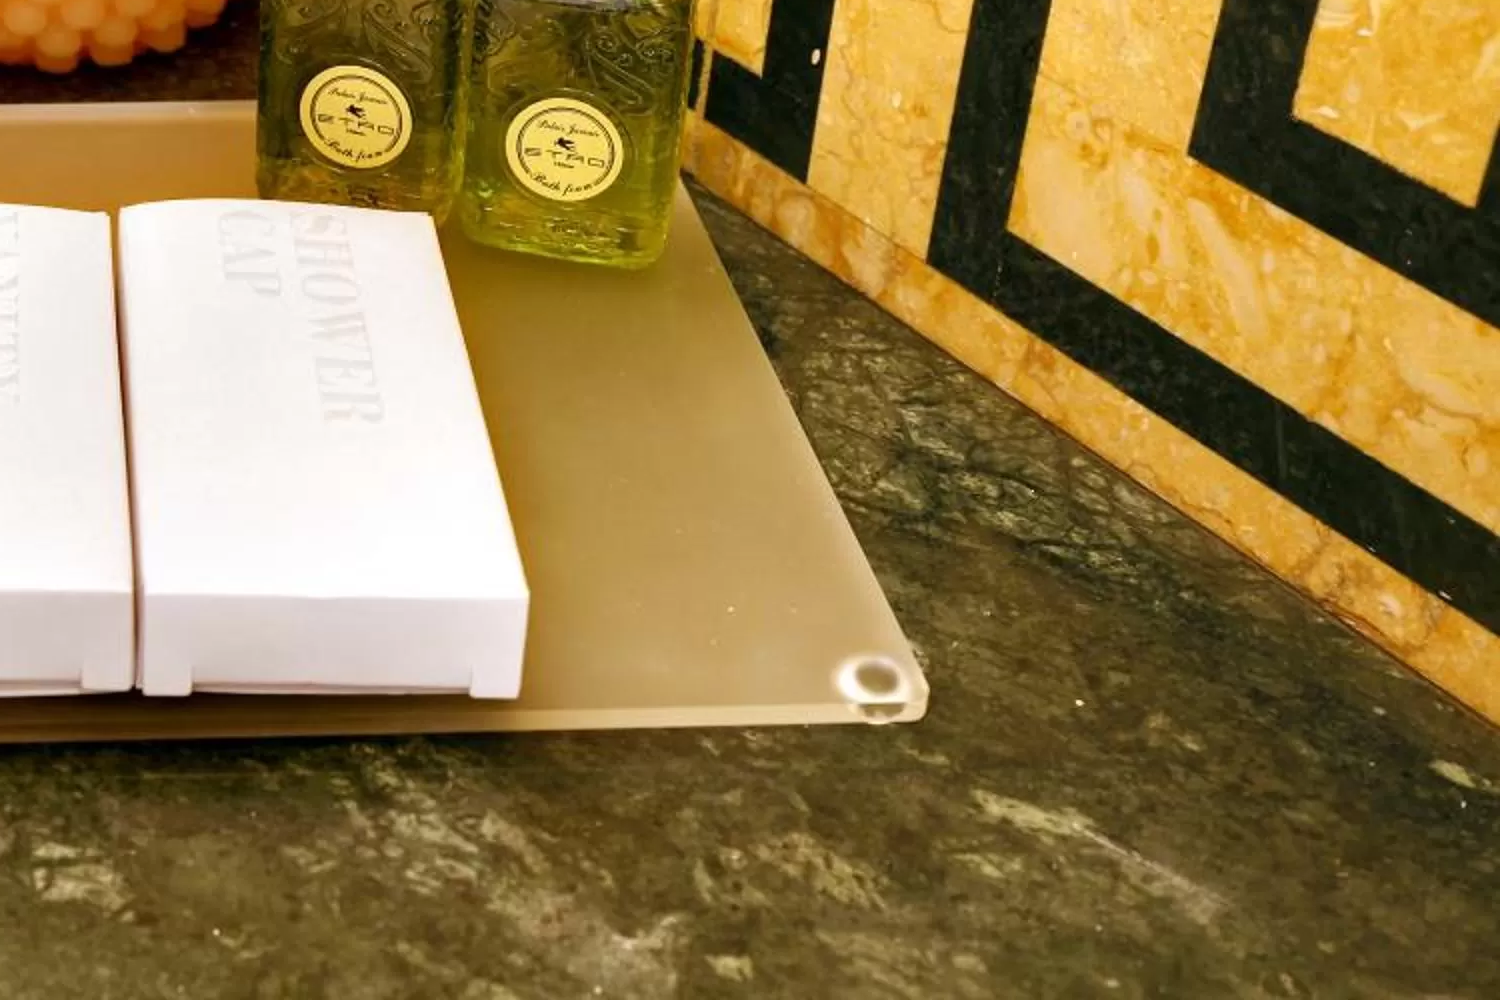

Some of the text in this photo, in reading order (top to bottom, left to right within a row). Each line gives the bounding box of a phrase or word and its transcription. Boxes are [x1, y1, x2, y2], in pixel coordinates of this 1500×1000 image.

[532, 173, 593, 197] Bath foam
[217, 209, 284, 297] CAP
[289, 210, 385, 425] SHOWER
